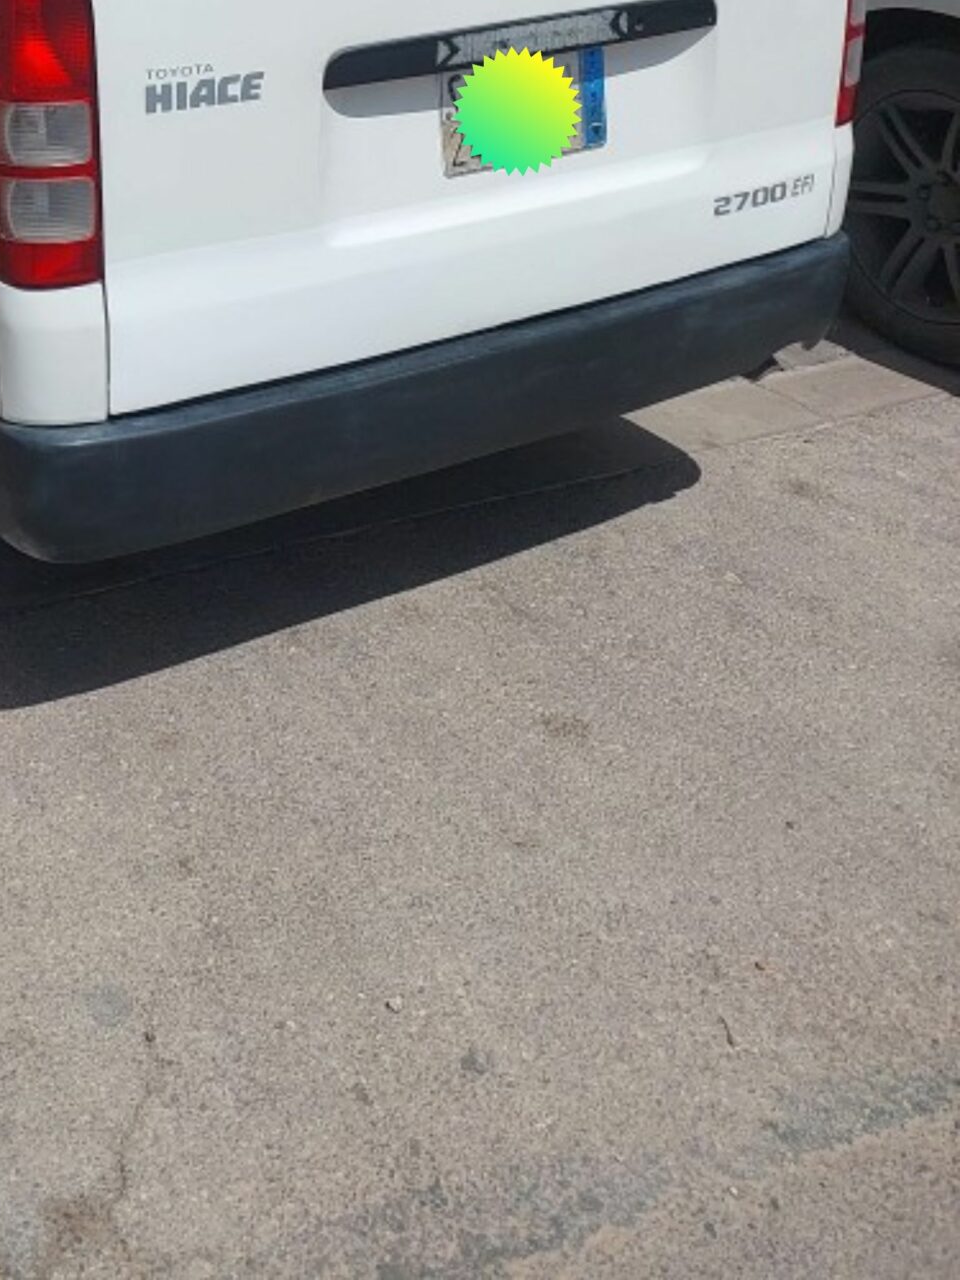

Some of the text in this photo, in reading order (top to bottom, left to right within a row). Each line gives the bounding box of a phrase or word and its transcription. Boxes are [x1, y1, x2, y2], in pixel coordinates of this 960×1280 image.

[145, 63, 215, 80] TOYOTA
[145, 71, 265, 114] HIACE
[713, 181, 787, 216] 2700
